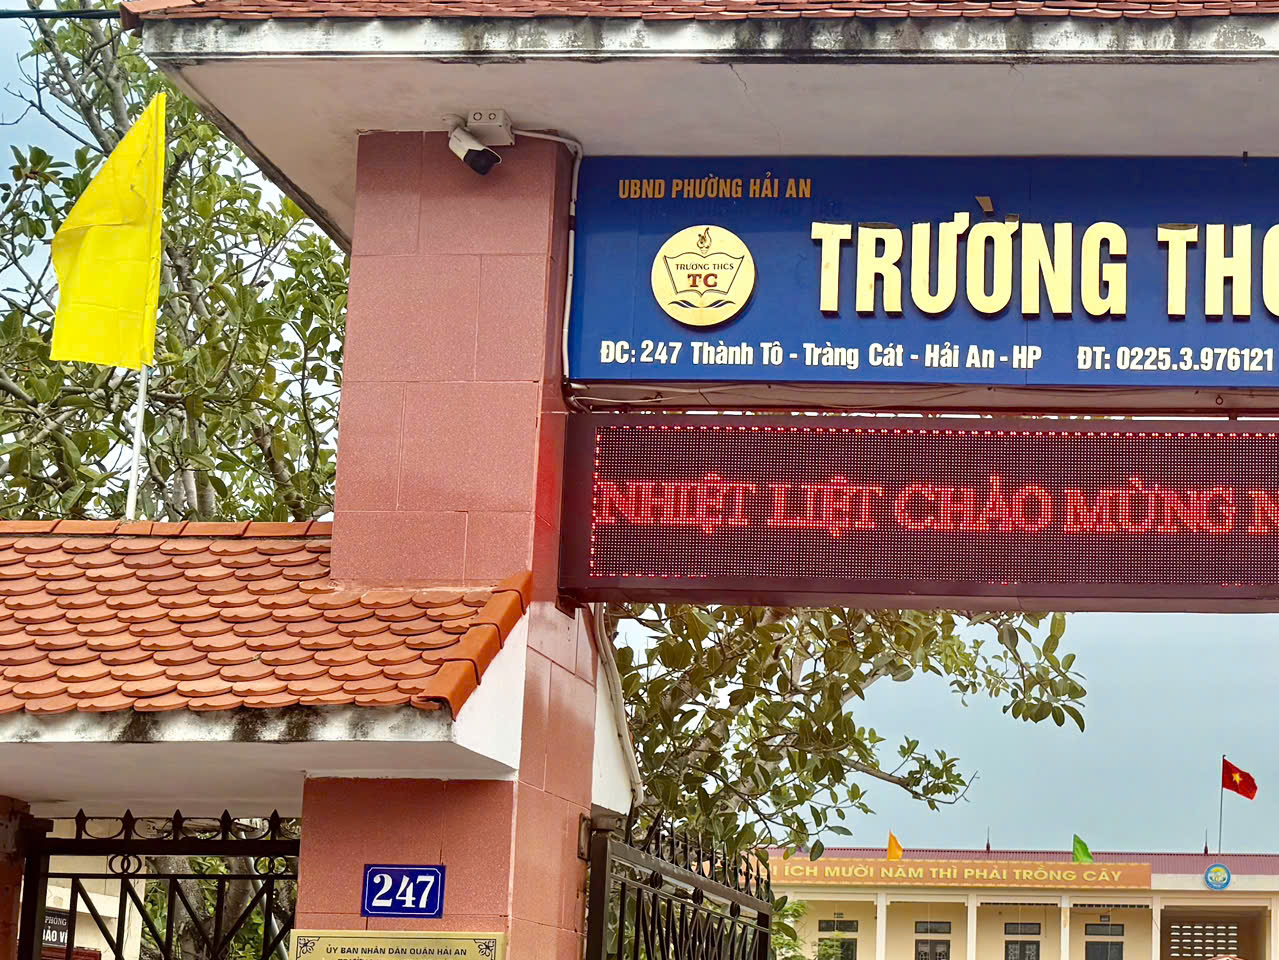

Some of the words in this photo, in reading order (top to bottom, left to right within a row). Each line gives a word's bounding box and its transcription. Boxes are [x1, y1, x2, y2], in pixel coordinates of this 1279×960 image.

[618, 179, 665, 198] UBND
[671, 173, 742, 198] PHƯỜNG
[749, 171, 779, 198] HẢI
[785, 178, 812, 198] AN
[712, 262, 734, 271] THCS
[811, 196, 1128, 319] TRƯỜNG
[687, 273, 718, 288] TC
[600, 340, 636, 364] ĐC:
[640, 340, 682, 364] 247
[690, 340, 754, 366] Thành
[760, 341, 784, 366] Tô
[803, 342, 860, 370] Tràng
[868, 342, 904, 368] Cát
[924, 342, 960, 369] Hải
[966, 348, 995, 369] An
[1012, 345, 1043, 370] HP
[1077, 345, 1111, 370] ĐT:
[1116, 346, 1273, 372] 0225.3.976121
[596, 472, 756, 535] NHIỆT
[766, 475, 883, 538] LIỆT
[894, 475, 1052, 533] CHÀO
[1063, 475, 1236, 533] MỪNG
[784, 863, 818, 878] ÍCH
[824, 863, 874, 879] MƯỜI
[881, 863, 923, 879] NĂM
[930, 865, 957, 880] THÌ
[964, 865, 1007, 881] PHẢI
[1013, 865, 1077, 882] TRỒNG
[1083, 867, 1122, 882] CÂY
[371, 873, 435, 909] 247
[340, 946, 359, 955] BAN
[454, 948, 467, 957] AN
